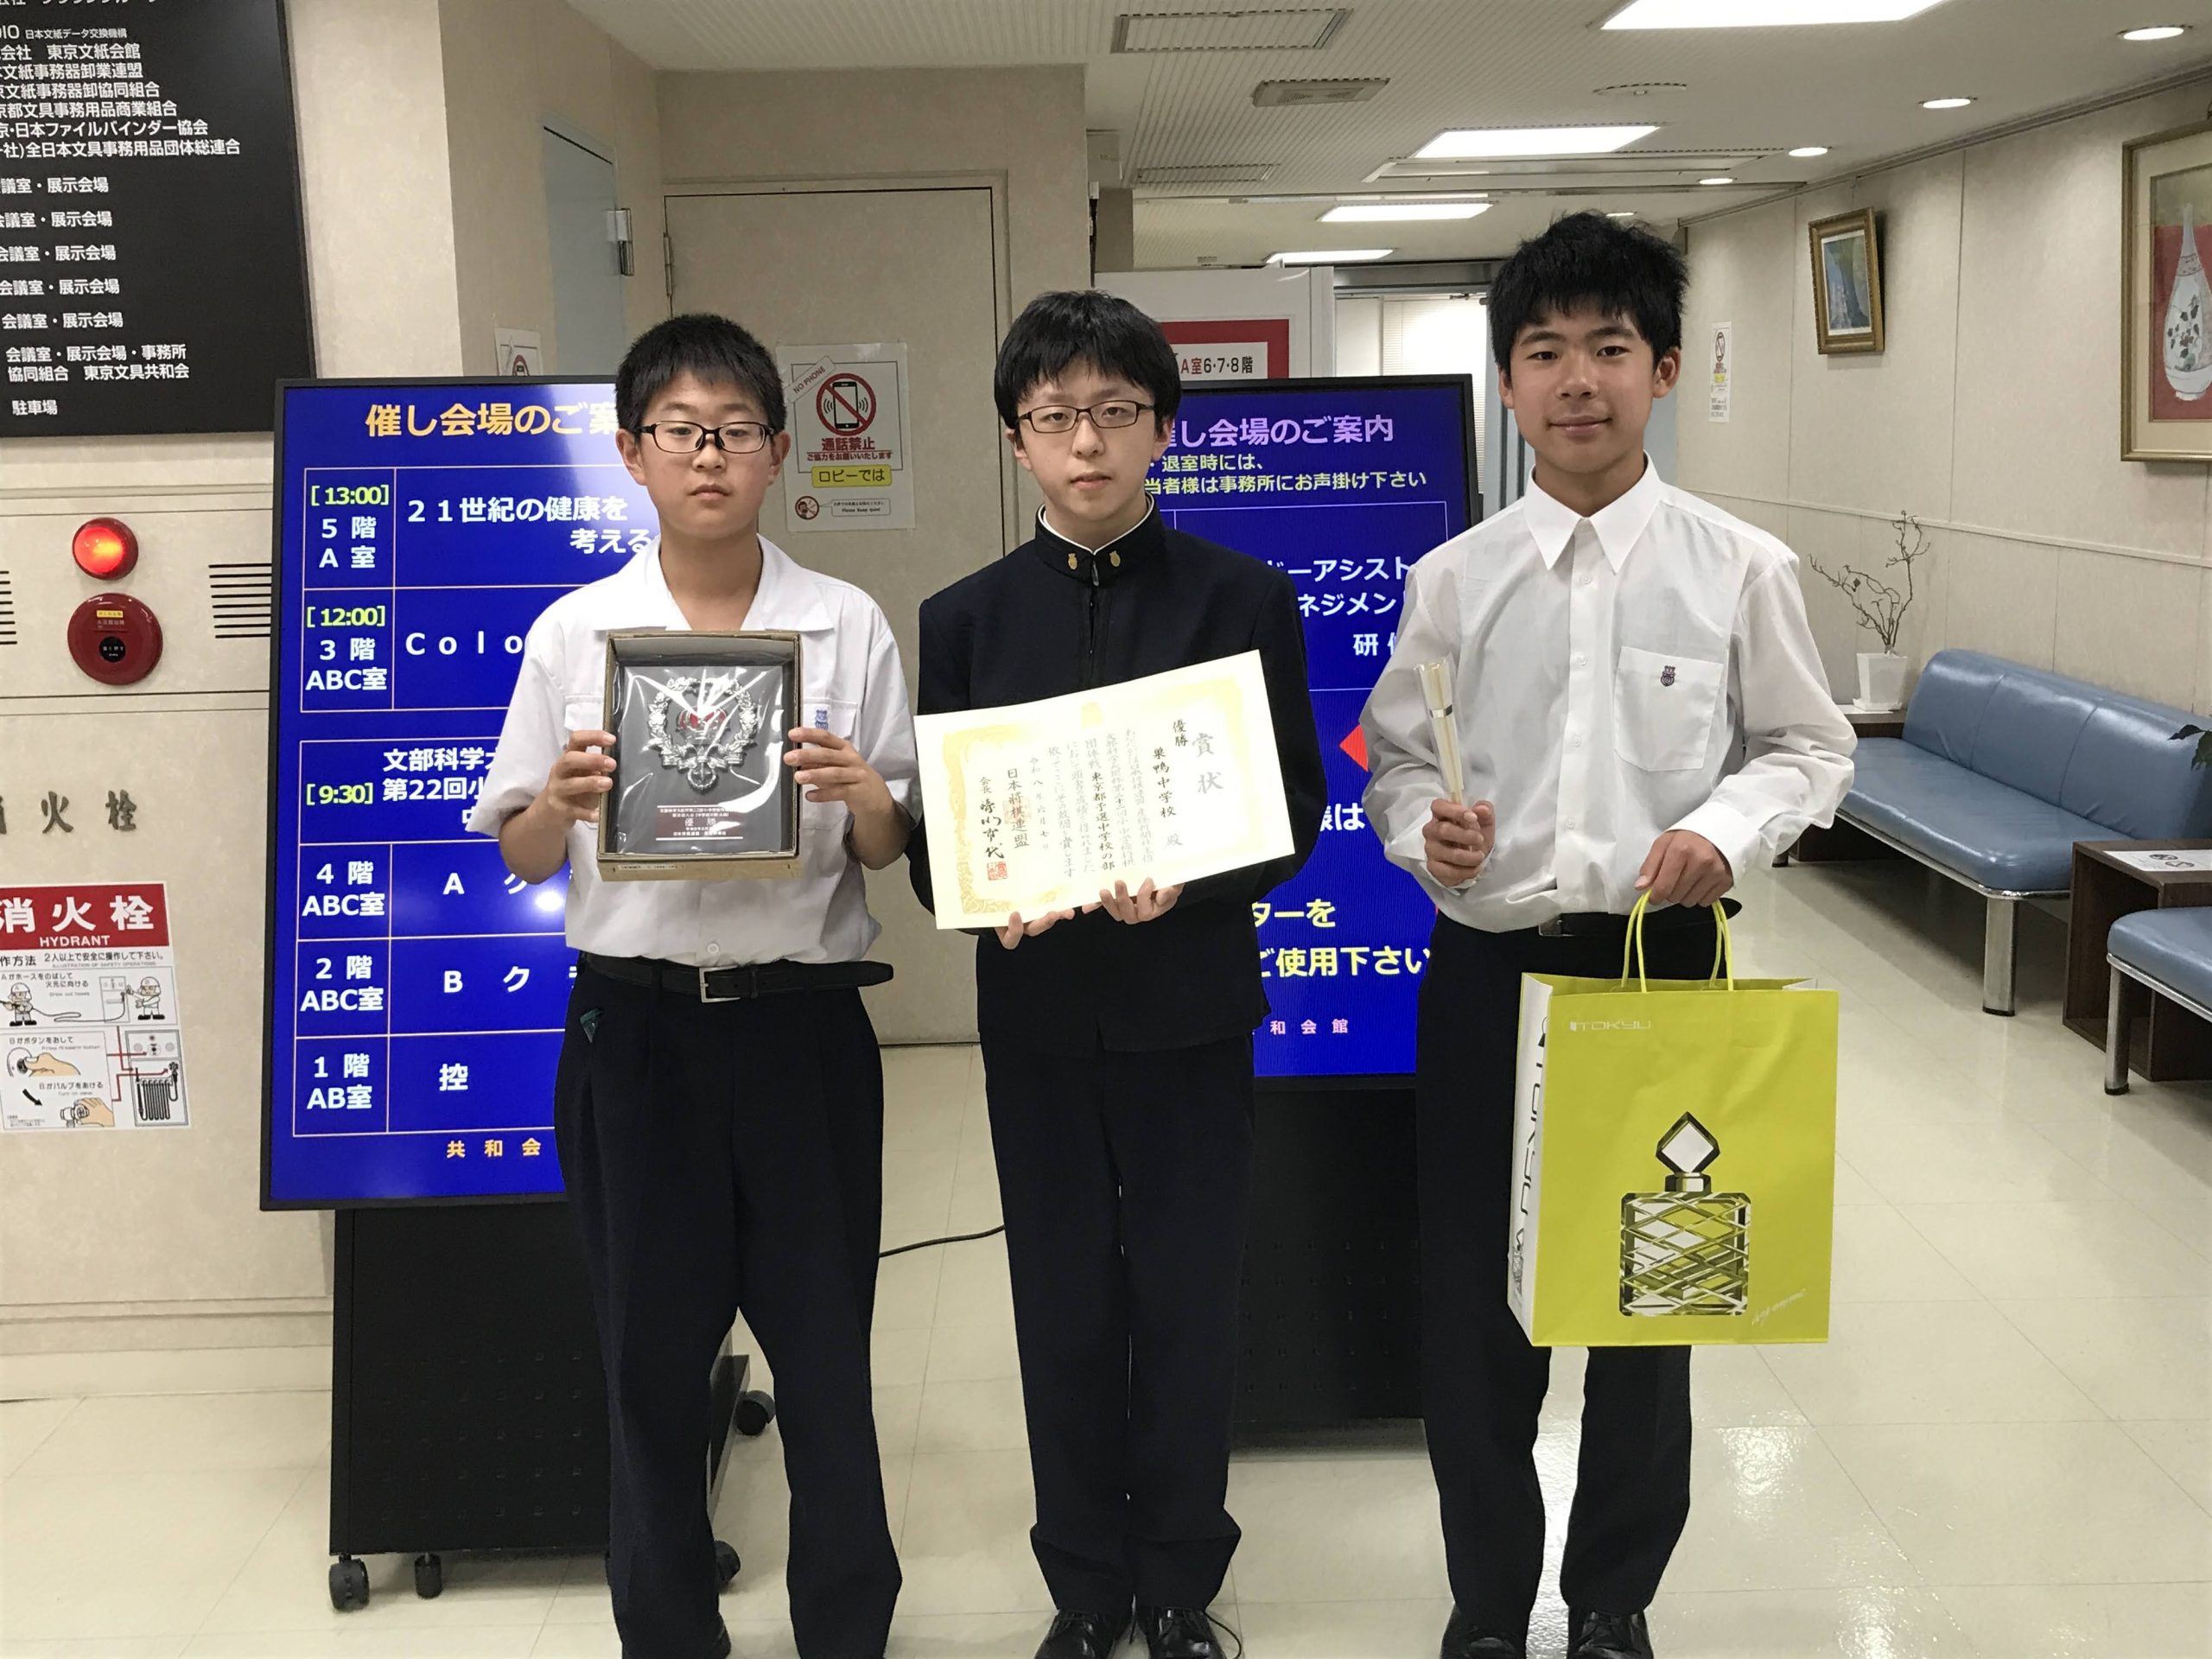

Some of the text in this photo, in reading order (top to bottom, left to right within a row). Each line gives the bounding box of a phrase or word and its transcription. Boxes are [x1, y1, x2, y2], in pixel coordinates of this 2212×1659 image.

[0, 25, 127, 40] IO 日本文紙データ交換機構
[0, 42, 141, 60] 会社 東京文紙会館
[0, 62, 143, 79] 文紙事務器卸業連盟
[0, 138, 240, 159] 社)全日本文具事務用品団体総連合
[0, 176, 109, 194] 議室・展示会場
[0, 278, 120, 296] 会議室・展示会場
[2, 312, 124, 329] 会議室・展示会場
[6, 344, 187, 363] 会議室・展示会場・事務所
[8, 363, 189, 383] 協同組合 東京文具共和会
[792, 365, 826, 394] NO PHONE
[12, 399, 58, 416] 駐車場
[822, 436, 875, 451] 通話禁止
[1168, 415, 1393, 448] し会場のご案内
[807, 452, 893, 461] ご協力をお願いいたします
[818, 468, 886, 482] ロビーでは
[1145, 471, 1427, 495] 当者様は事務所にお声掛け下さい
[1267, 556, 1410, 582] ーアシスト
[1298, 592, 1405, 617] ネジメン
[305, 667, 387, 691] ABC室
[1173, 719, 1188, 747] 優勝
[1192, 733, 1224, 794] 賞状
[980, 777, 993, 794] 会長
[1153, 747, 1177, 817] 巣鴨中学校
[0, 790, 137, 835] 火栓
[1007, 768, 1030, 849] 日本将棋連盟
[0, 895, 154, 934] 消火栓
[302, 892, 385, 916] ABC室
[40, 935, 111, 947] HYDRANT
[300, 987, 384, 1012] ABC室
[439, 1063, 468, 1091] 控
[306, 1084, 372, 1109] AB室
